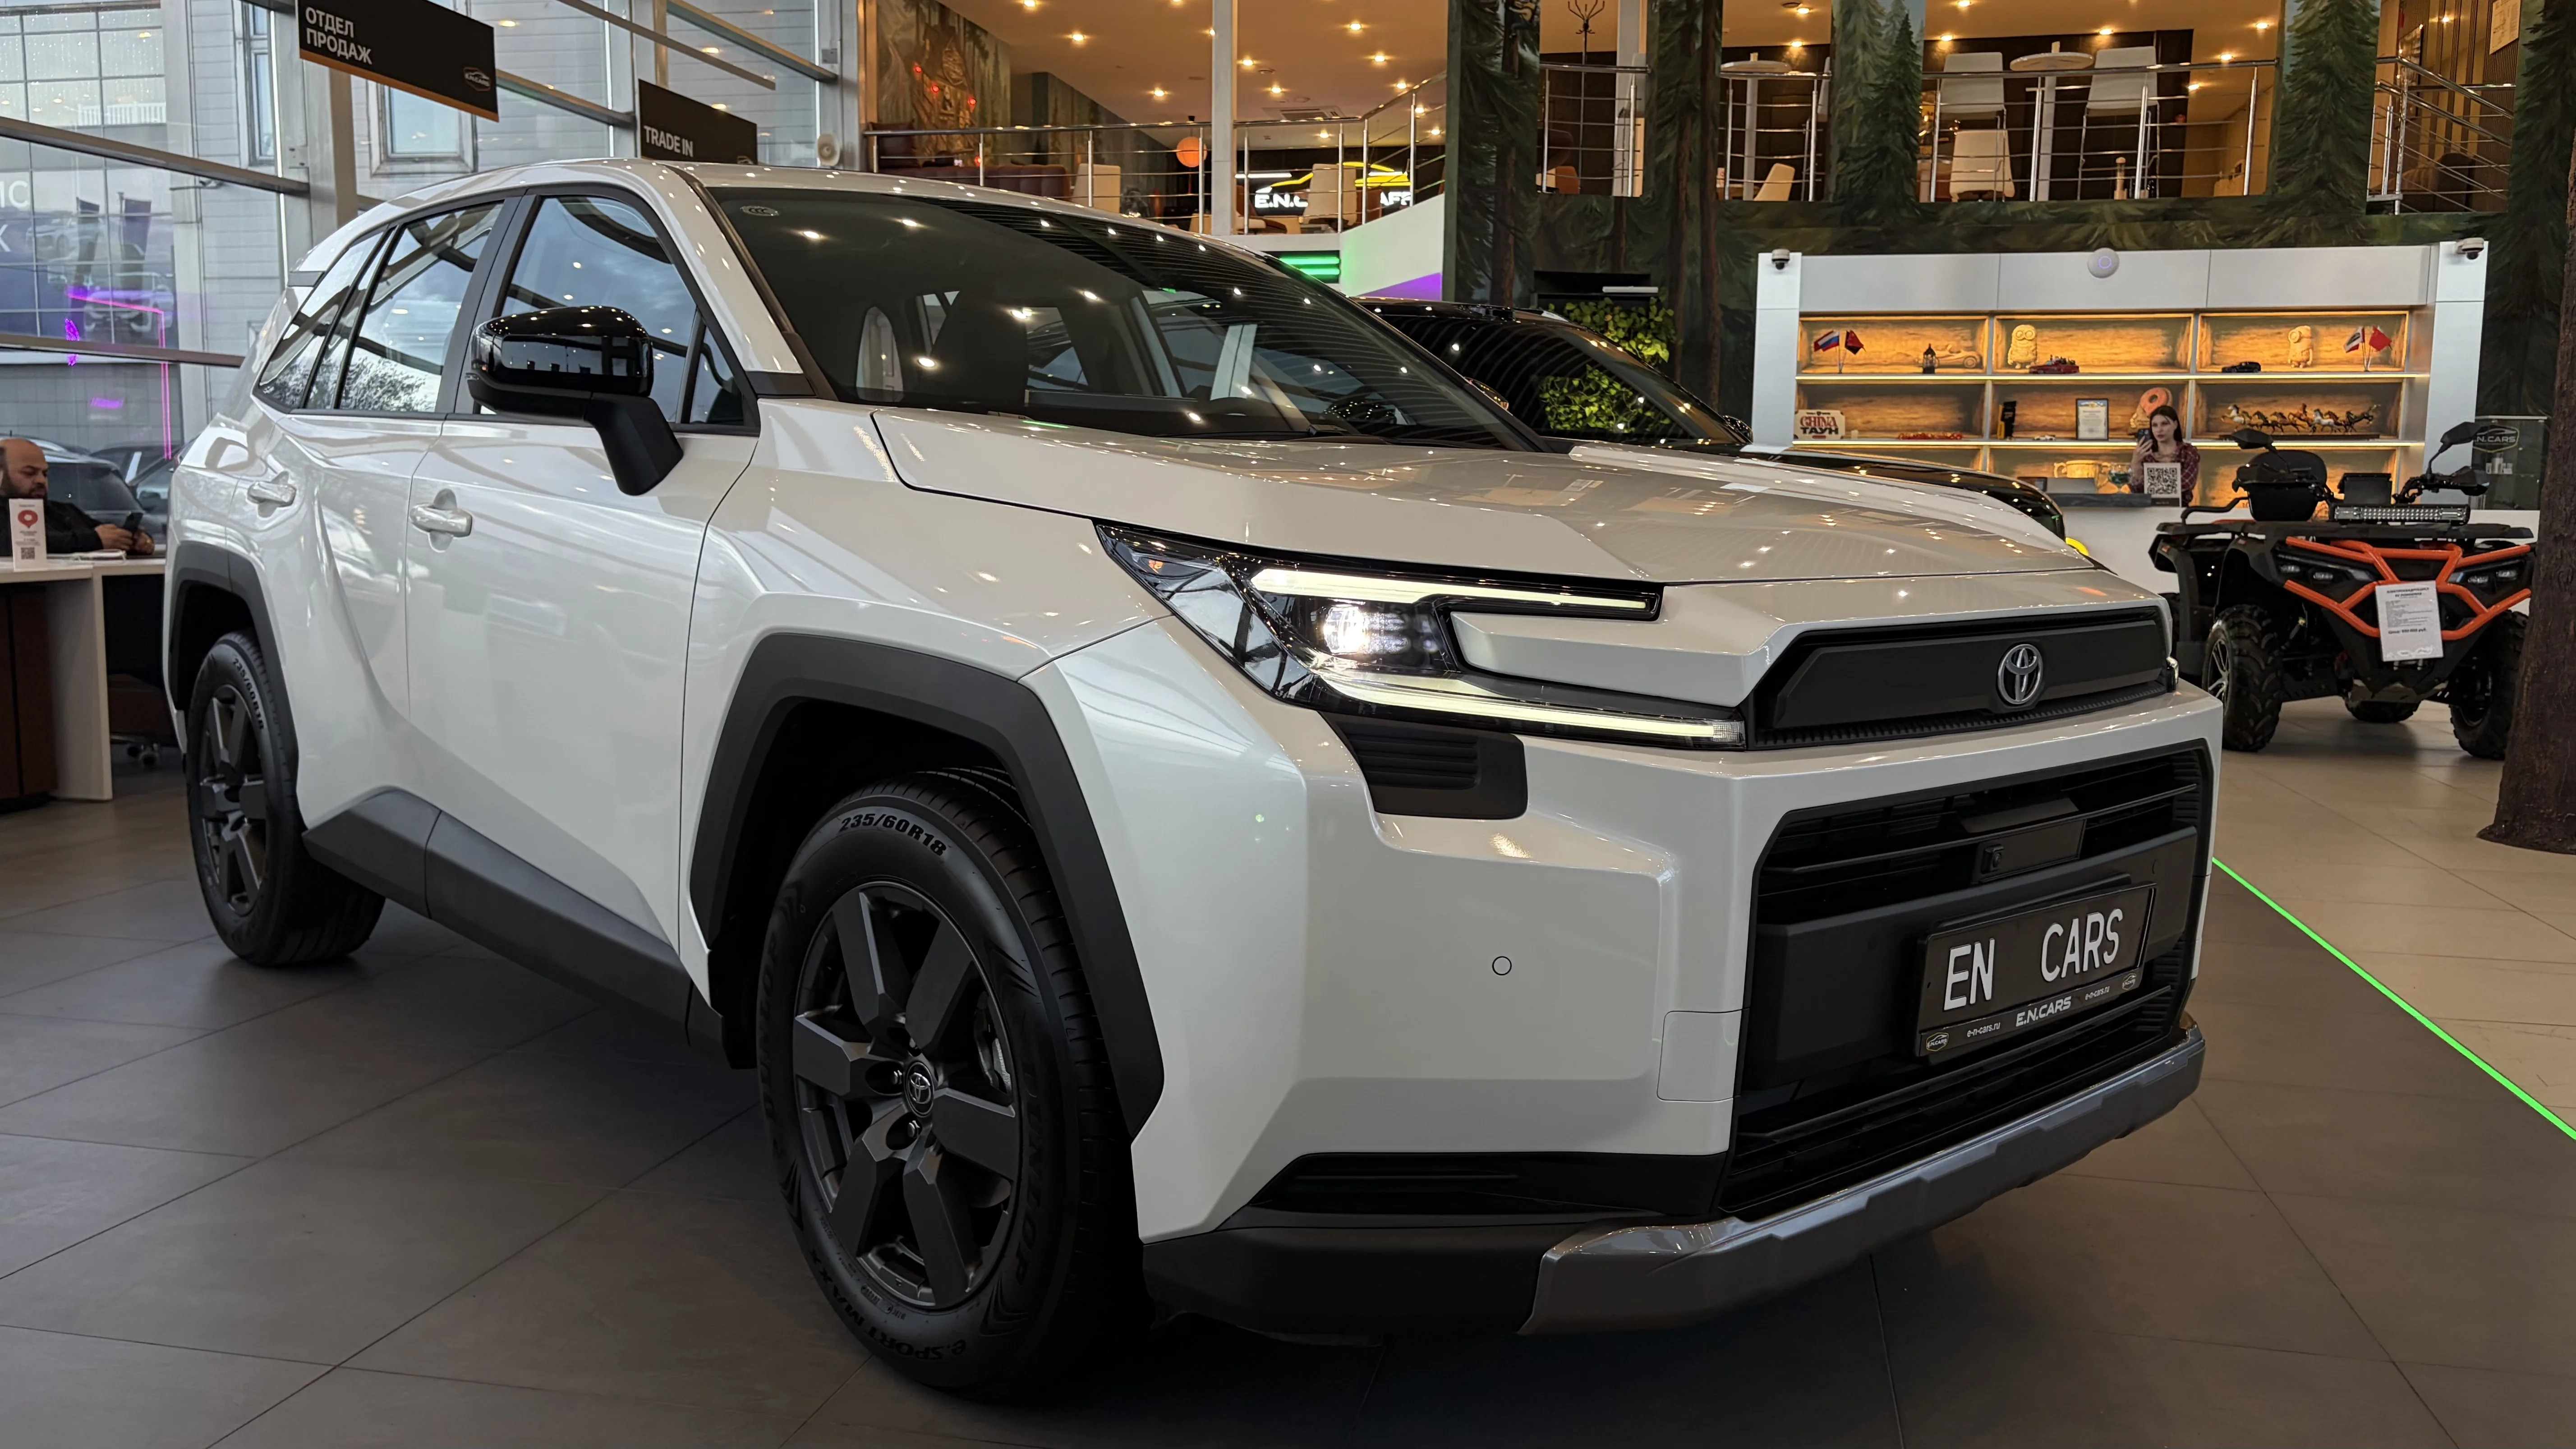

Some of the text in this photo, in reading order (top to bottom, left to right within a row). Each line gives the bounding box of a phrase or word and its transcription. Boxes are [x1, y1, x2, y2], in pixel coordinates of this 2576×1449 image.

[305, 7, 354, 38] ОТДЕЛ
[307, 28, 372, 64] ПРОДАЖ
[644, 125, 694, 157] TRADE IN
[1255, 193, 1308, 208] E.N.C
[1799, 416, 1838, 427] CHINA
[839, 813, 947, 856] 235/60R18
[1944, 908, 2123, 1011] EN CARS
[2015, 996, 2072, 1027] E.N.CARS
[1967, 1022, 2001, 1038] e-n-cars.ru
[810, 1251, 865, 1327] MAXX
